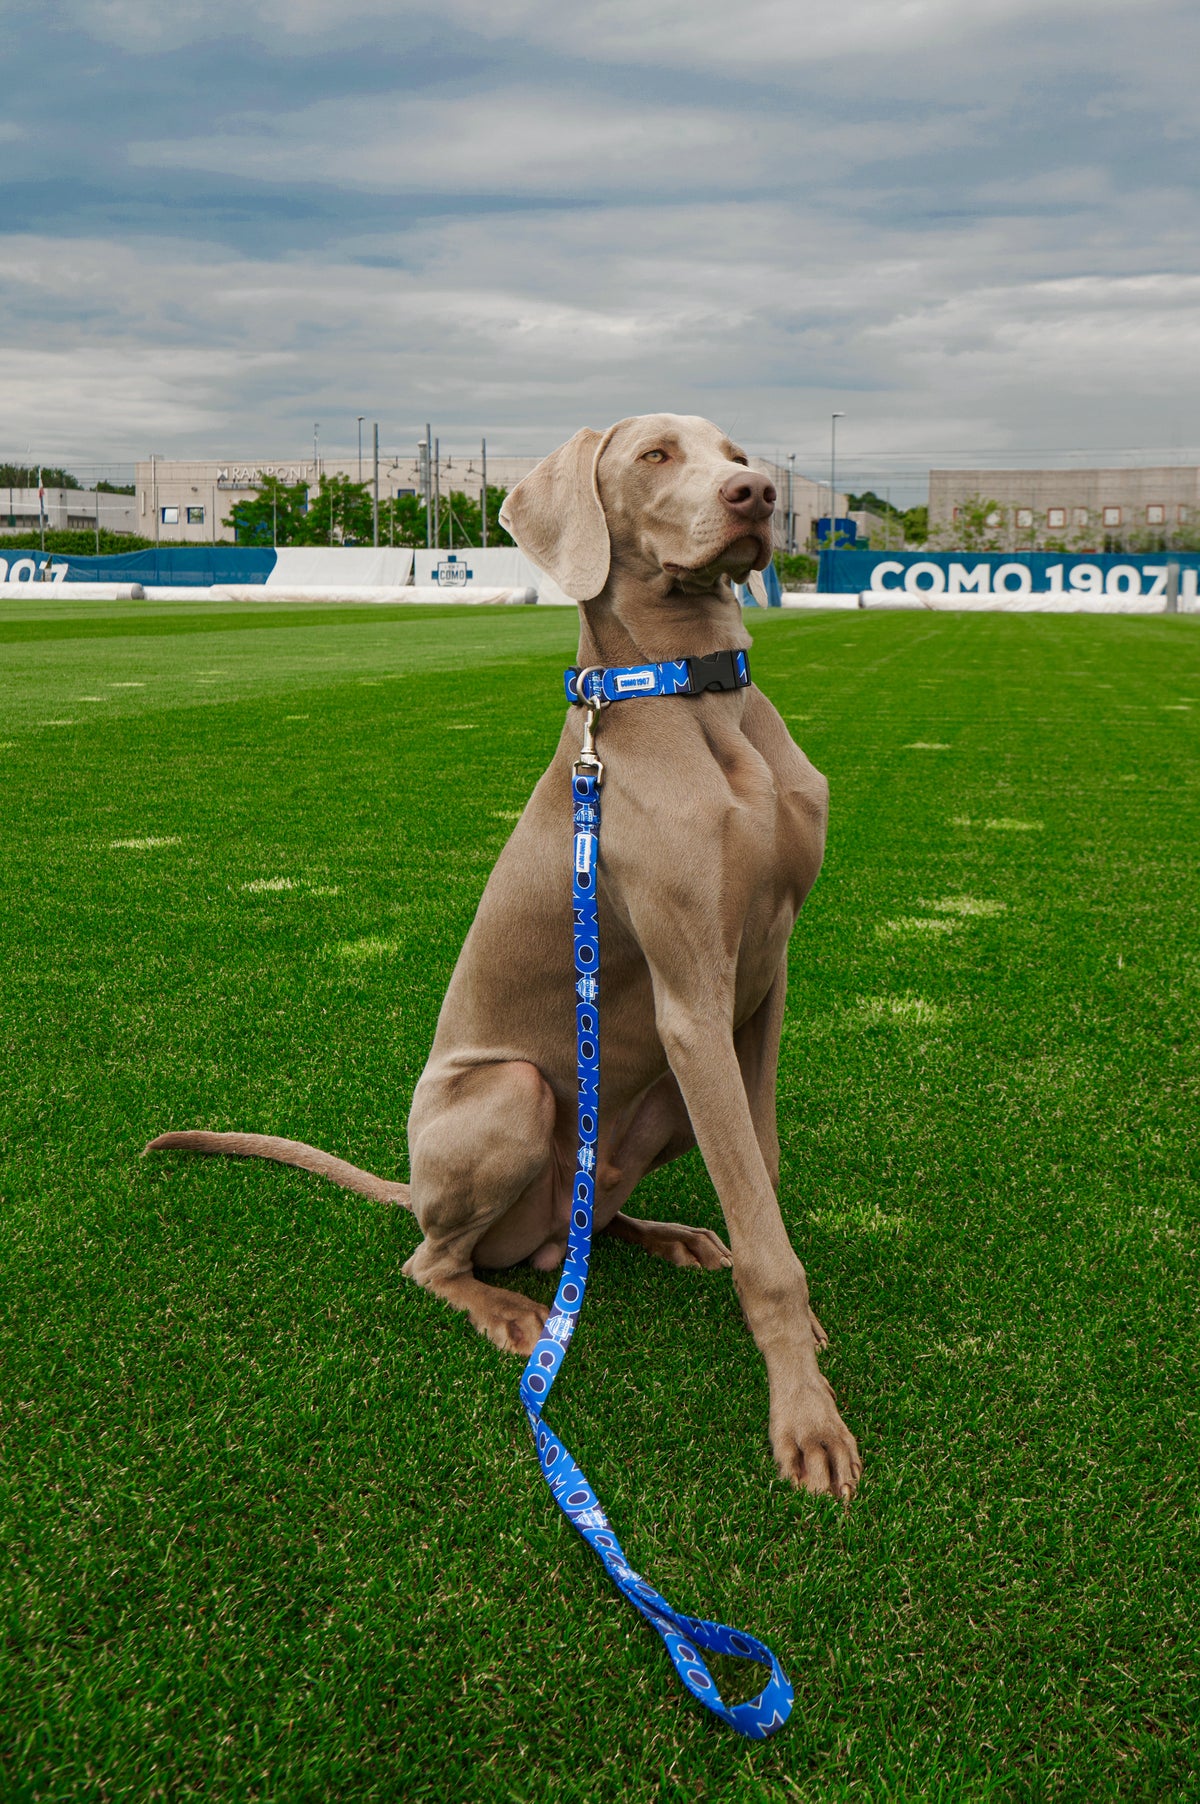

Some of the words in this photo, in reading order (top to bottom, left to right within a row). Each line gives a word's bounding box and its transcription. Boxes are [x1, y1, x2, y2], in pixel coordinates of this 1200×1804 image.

[440, 569, 465, 580] COMO
[870, 561, 1033, 594] COMO
[1045, 563, 1169, 595] 1907
[575, 1002, 600, 1144] COMO
[553, 1170, 595, 1315] COMO
